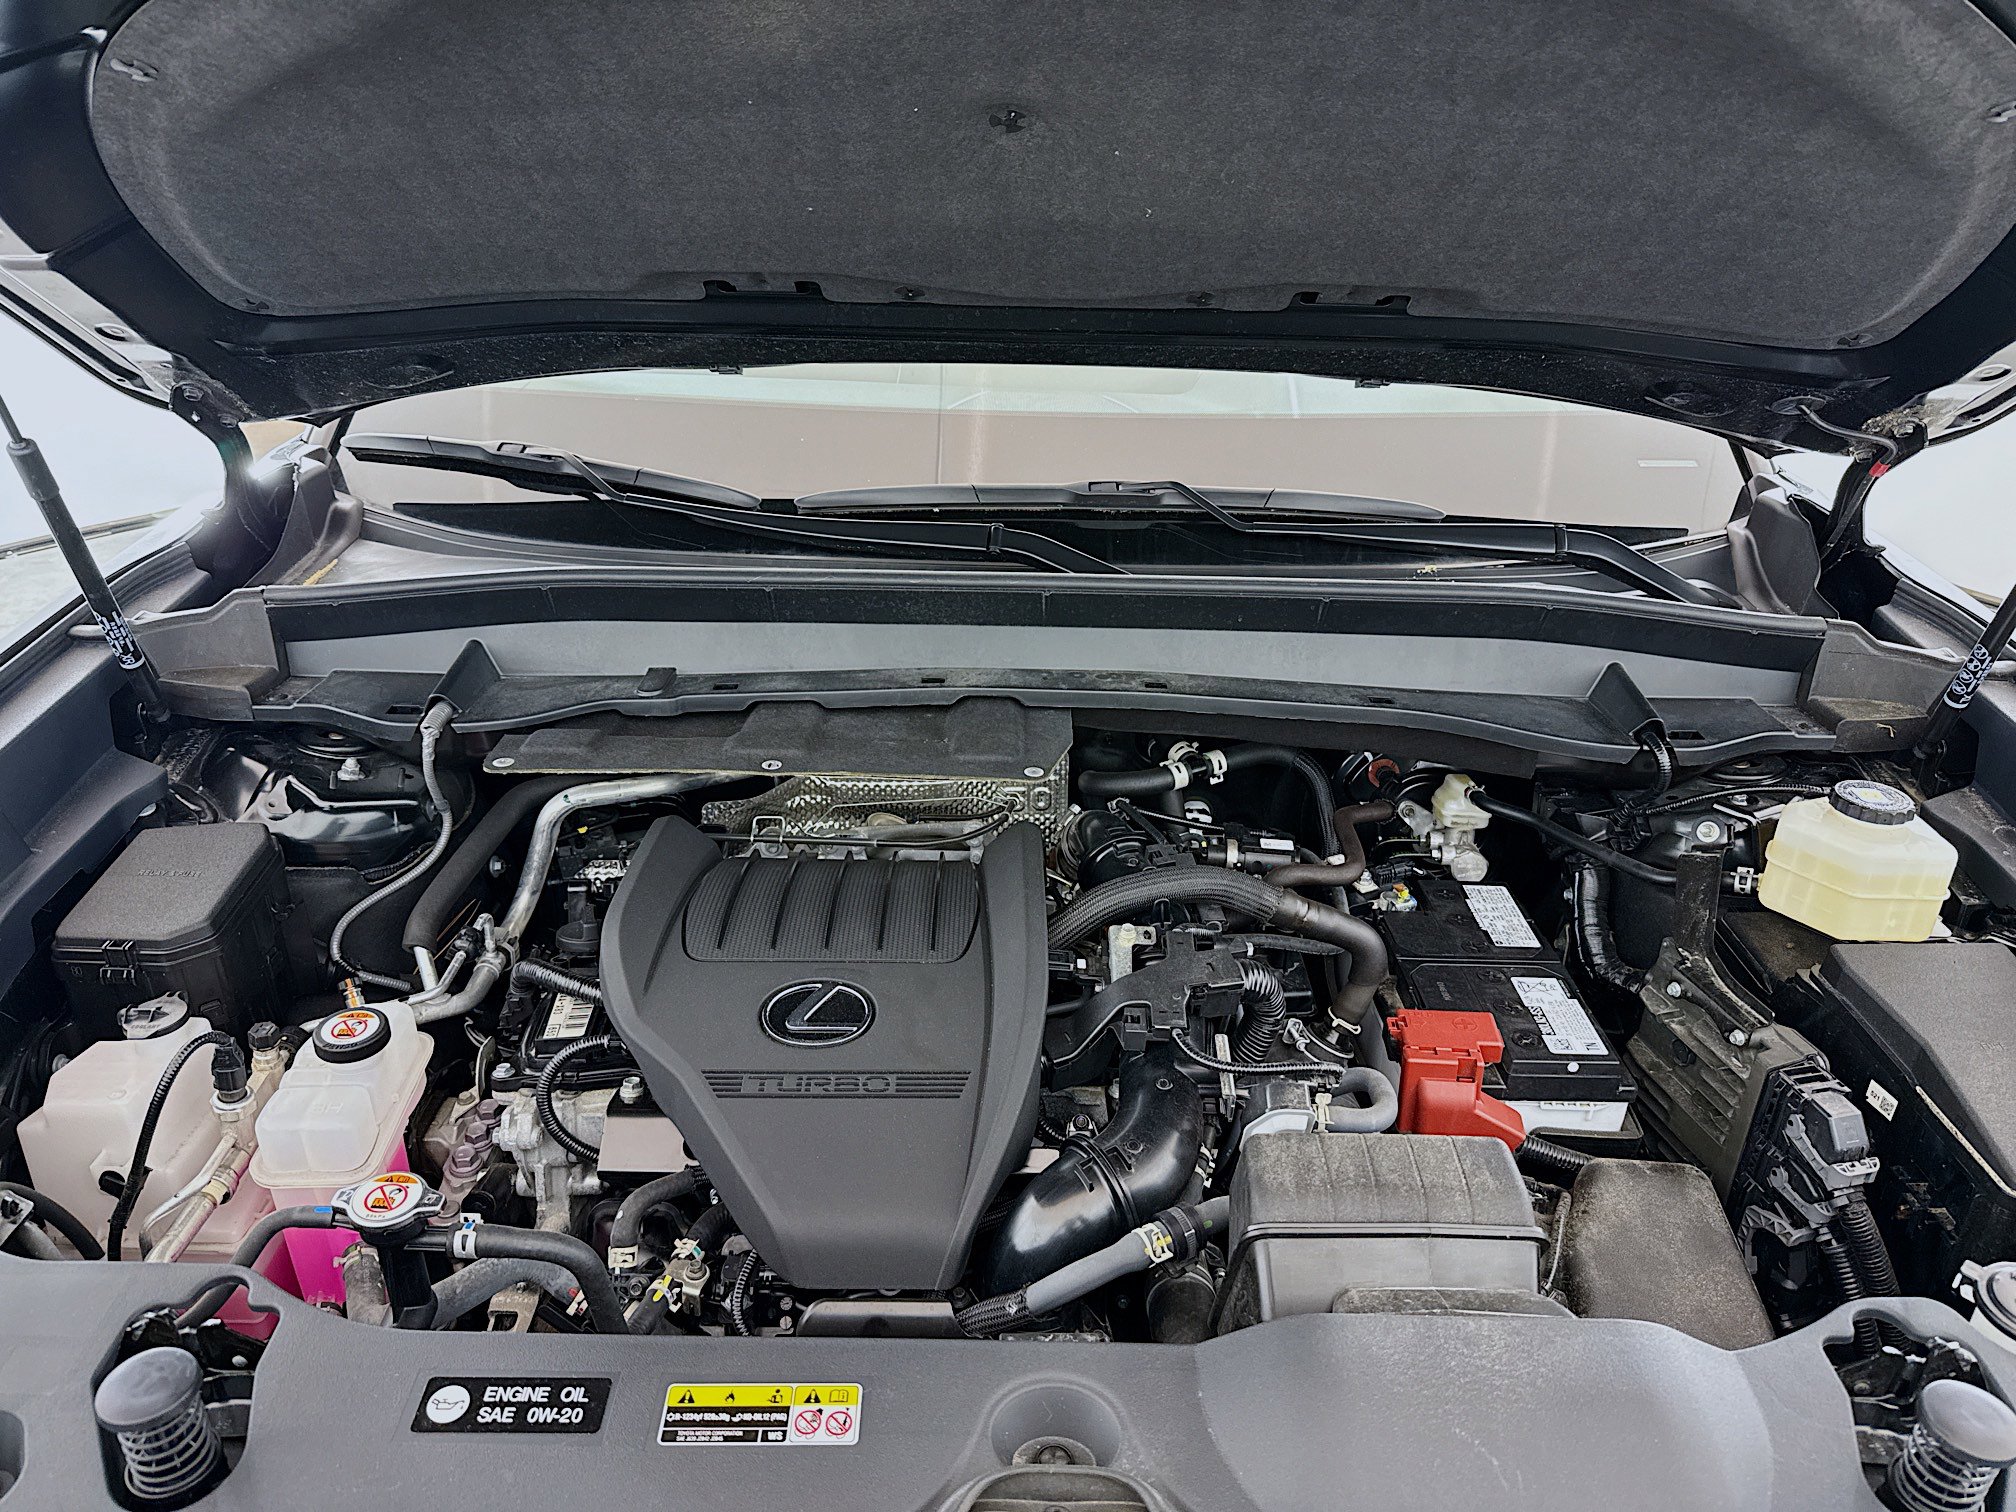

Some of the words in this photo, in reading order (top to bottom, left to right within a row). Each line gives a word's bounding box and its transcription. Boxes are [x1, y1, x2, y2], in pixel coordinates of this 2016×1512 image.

[746, 1074, 892, 1093] TURBO
[483, 1387, 551, 1402] ENGINE
[560, 1387, 589, 1402] OIL
[477, 1407, 516, 1423] SAE
[526, 1407, 584, 1423] 0W-20
